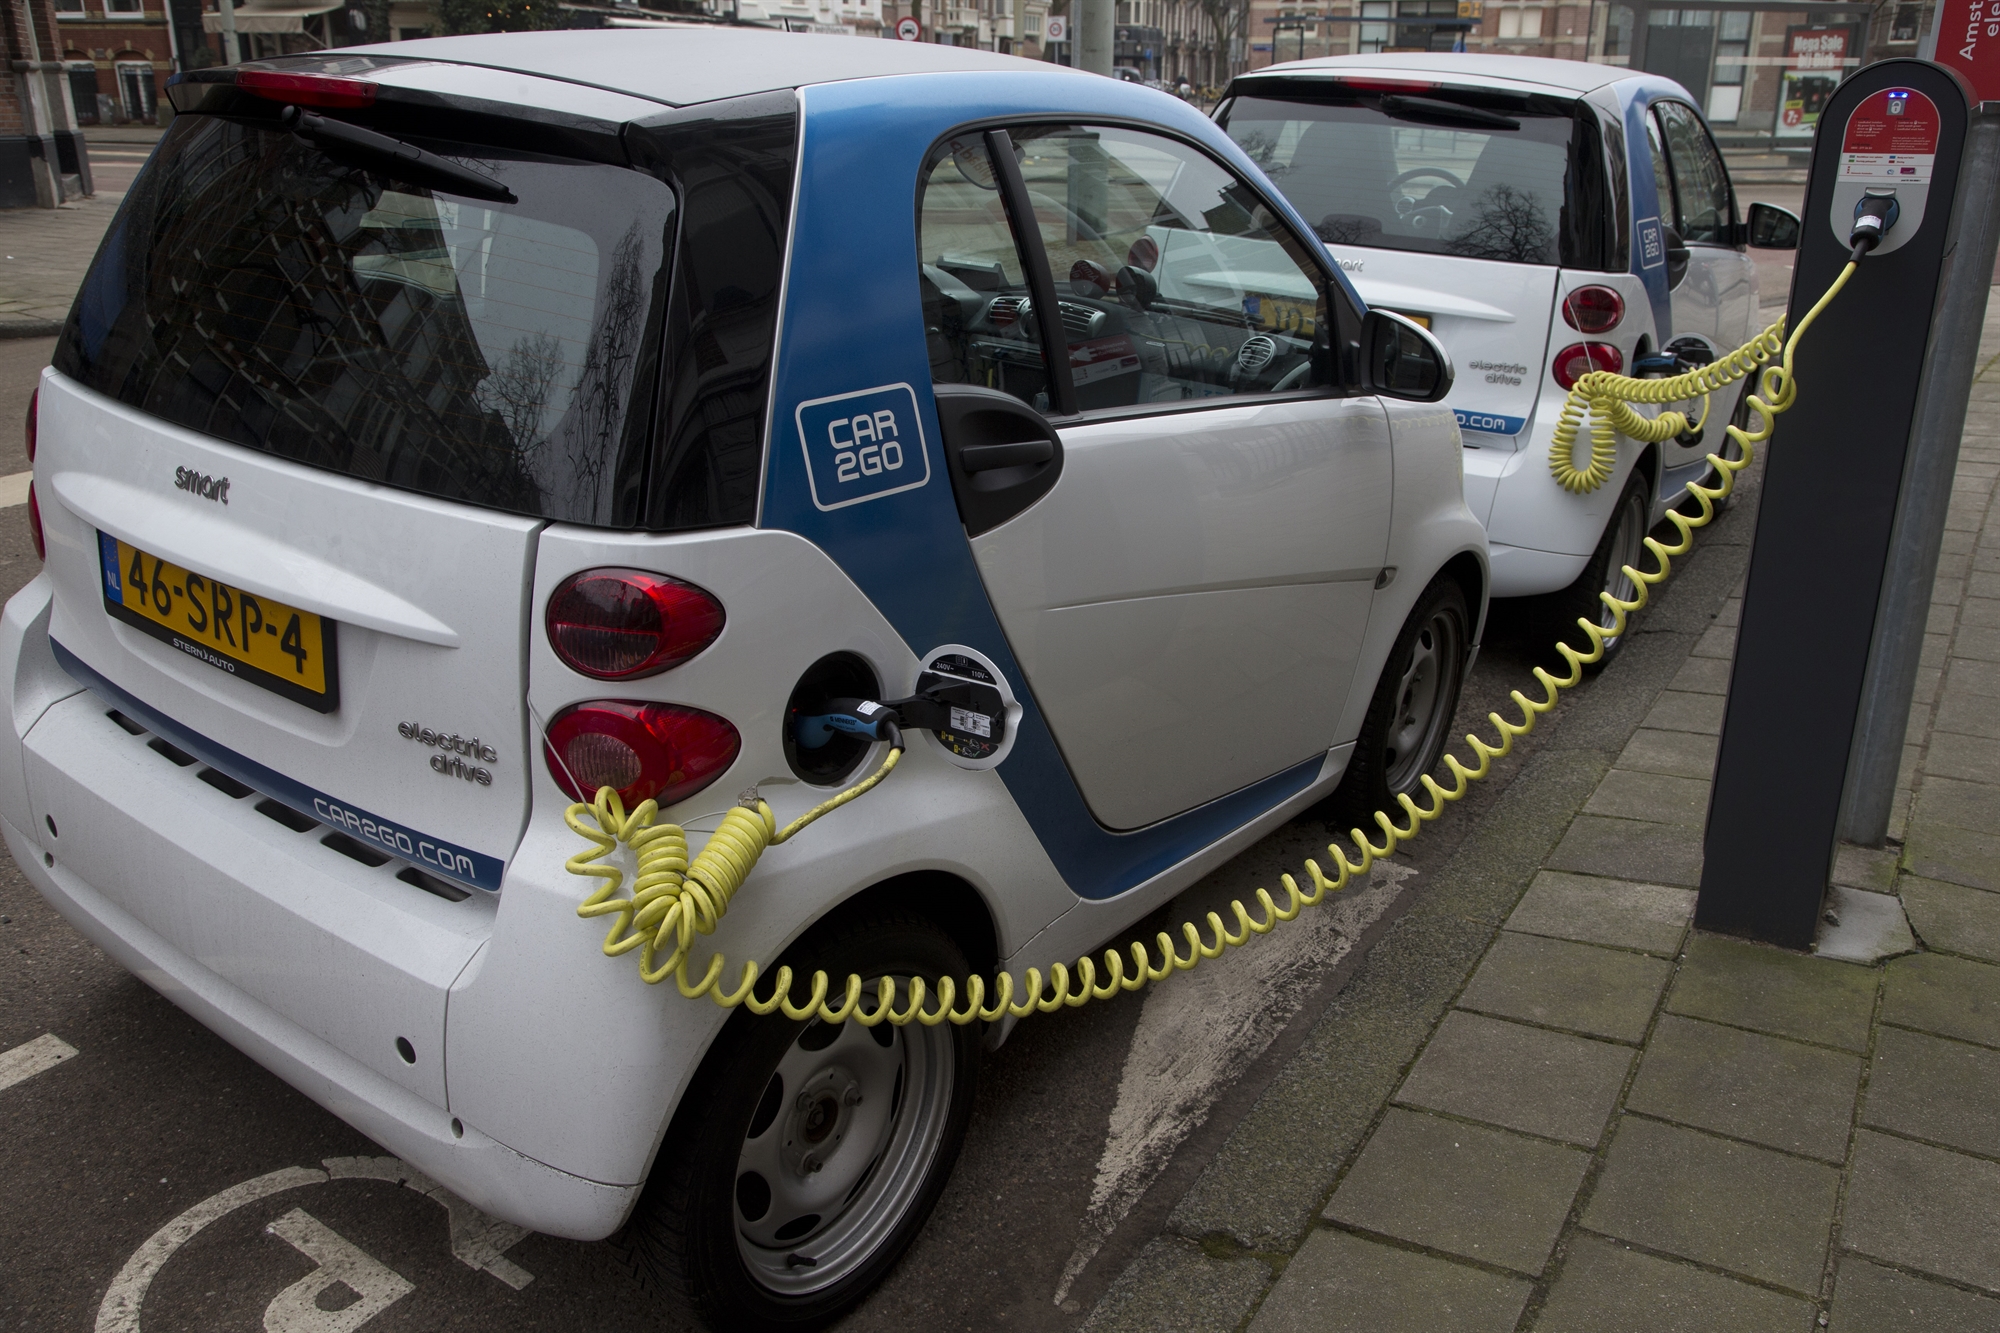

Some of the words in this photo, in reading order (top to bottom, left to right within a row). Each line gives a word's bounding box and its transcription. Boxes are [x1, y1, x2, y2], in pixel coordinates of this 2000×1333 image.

[1959, 1, 1984, 61] Amst
[1983, 0, 2000, 37] ele
[1793, 36, 1820, 52] Mega
[1820, 35, 1844, 50] Sale
[1469, 359, 1528, 376] electric
[1485, 372, 1522, 387] drive
[828, 409, 898, 449] CAR
[834, 441, 904, 483] 2GO
[174, 465, 231, 505] smart
[107, 569, 120, 591] NL
[128, 550, 308, 674] 46-SRP-4
[173, 638, 203, 659] STERN
[209, 654, 235, 673] AUTO
[398, 721, 497, 763] electric
[430, 753, 492, 786] drive
[313, 797, 476, 879] CAR2GO.COM
